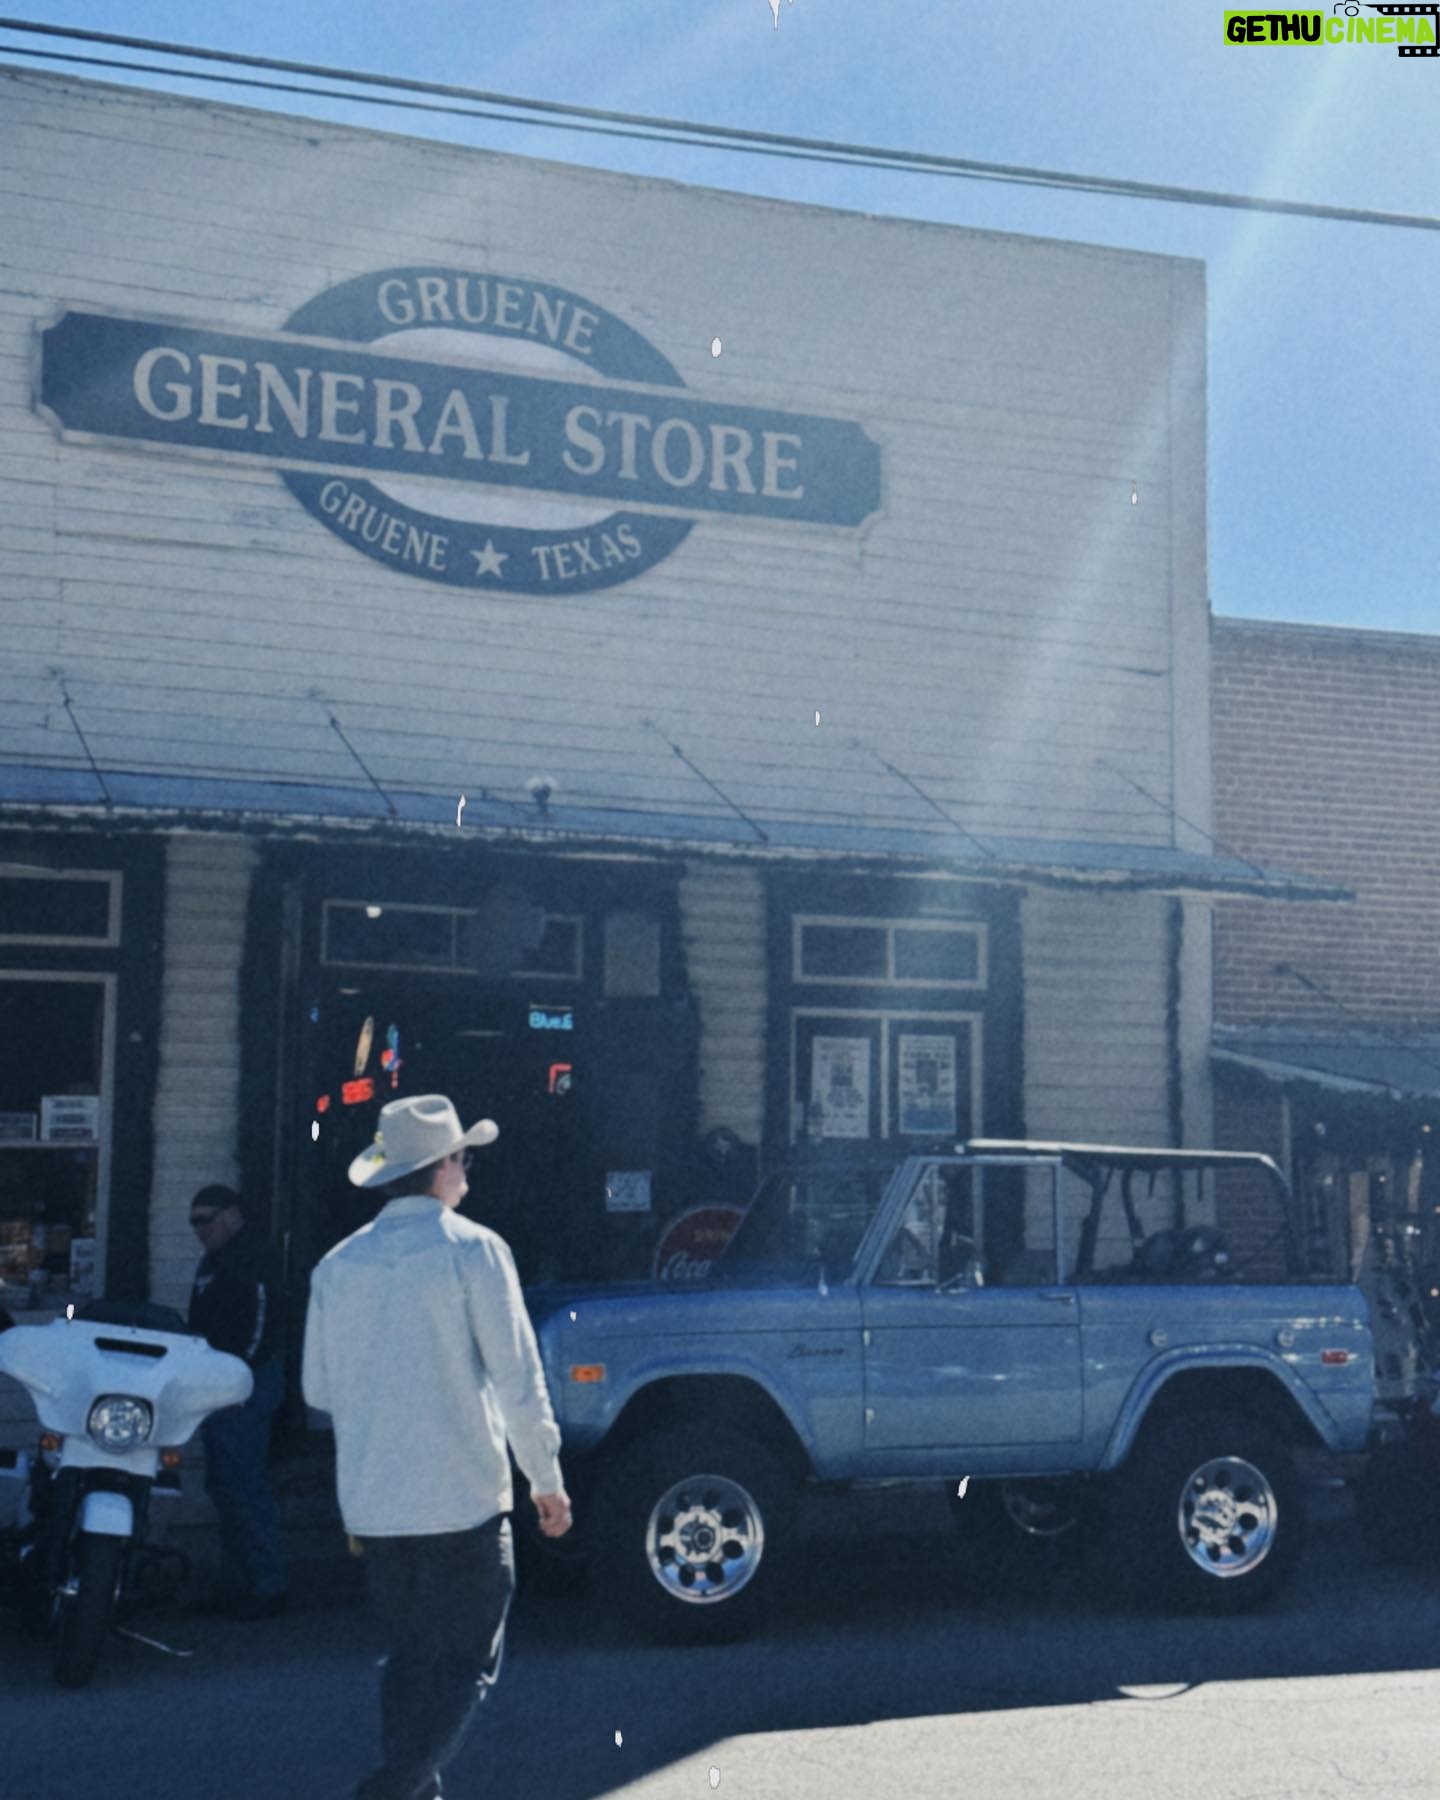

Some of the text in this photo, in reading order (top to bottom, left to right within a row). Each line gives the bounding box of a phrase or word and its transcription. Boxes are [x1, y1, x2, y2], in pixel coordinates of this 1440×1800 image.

[378, 278, 600, 354] GRUENE
[133, 348, 804, 499] GENERAL STORE
[319, 481, 642, 582] GRUENE TEXAS
